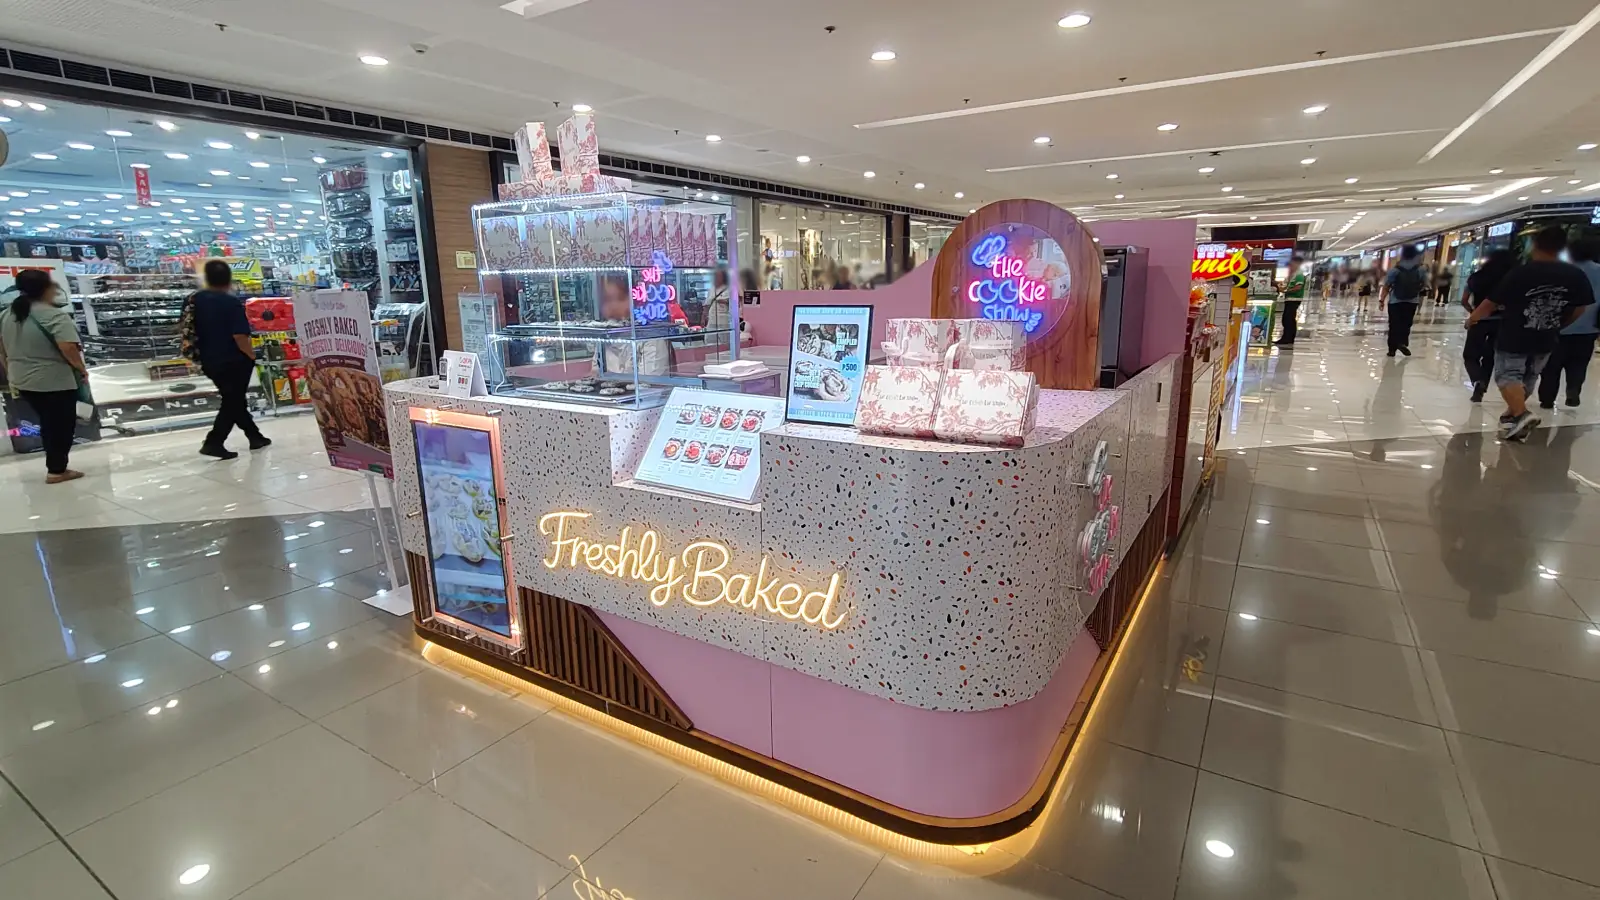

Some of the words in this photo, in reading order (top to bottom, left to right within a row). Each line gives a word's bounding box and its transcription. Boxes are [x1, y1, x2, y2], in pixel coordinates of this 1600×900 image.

[304, 317, 332, 339] FRESHLY
[333, 316, 361, 339] BAKED,
[106, 392, 258, 418] RANGR
[540, 511, 684, 607] Freshly
[682, 541, 848, 629] Baked
